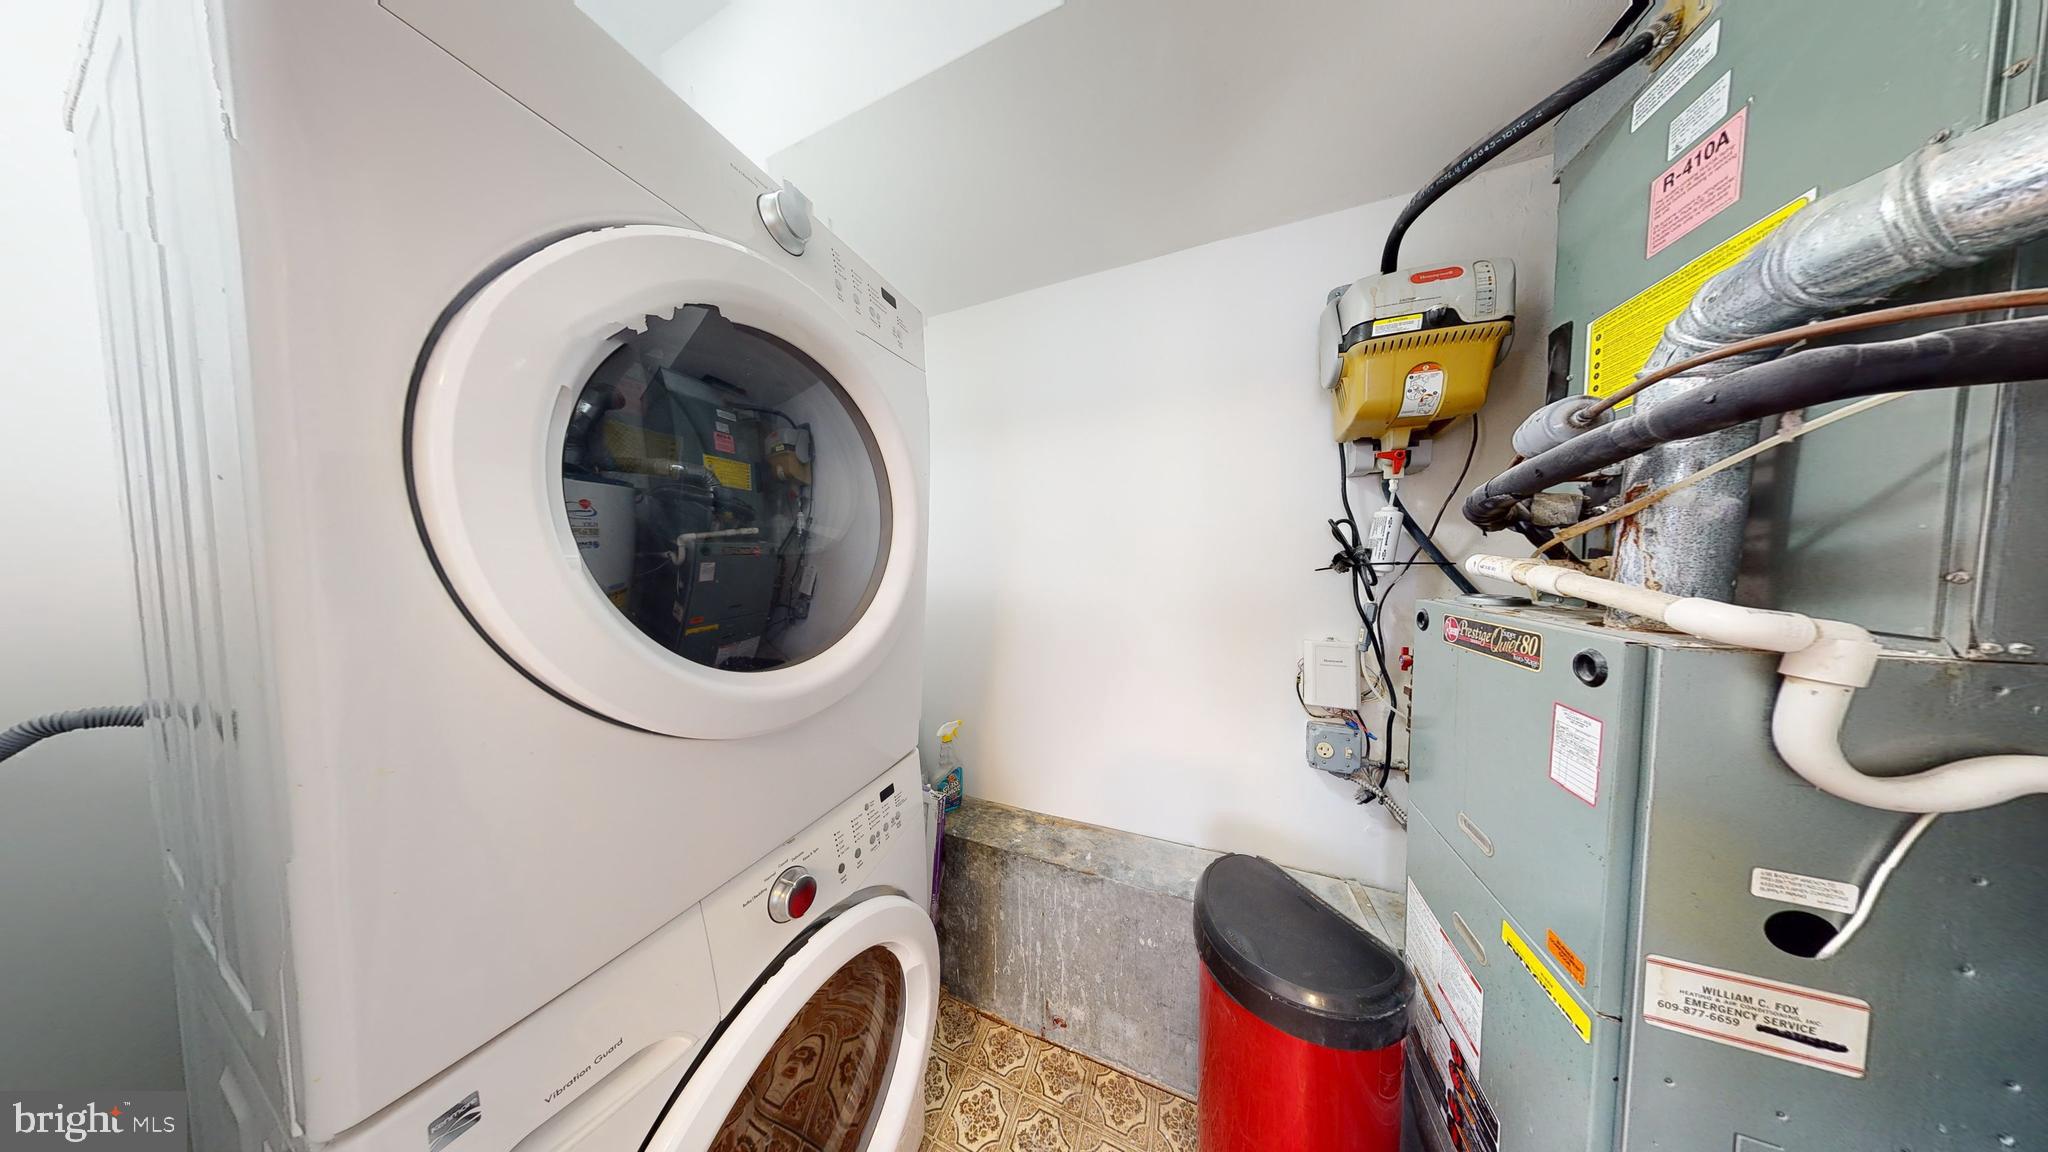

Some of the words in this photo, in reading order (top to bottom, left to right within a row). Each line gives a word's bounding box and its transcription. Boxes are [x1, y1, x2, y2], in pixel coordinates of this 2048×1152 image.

[1663, 130, 1730, 193] R-410A
[1460, 620, 1491, 646] Prestige
[1490, 627, 1522, 653] Quiet
[1520, 635, 1539, 656] 80
[1657, 999, 1741, 1027] 609-877-6659
[1684, 996, 1758, 1021] EMERGENCY
[1763, 1015, 1818, 1036] SERVICE
[1702, 985, 1753, 1005] WILLIAM
[1758, 999, 1770, 1009] C.
[1775, 1002, 1799, 1016] FOX
[544, 1064, 592, 1103] Vibration
[594, 1036, 623, 1065] Guard
